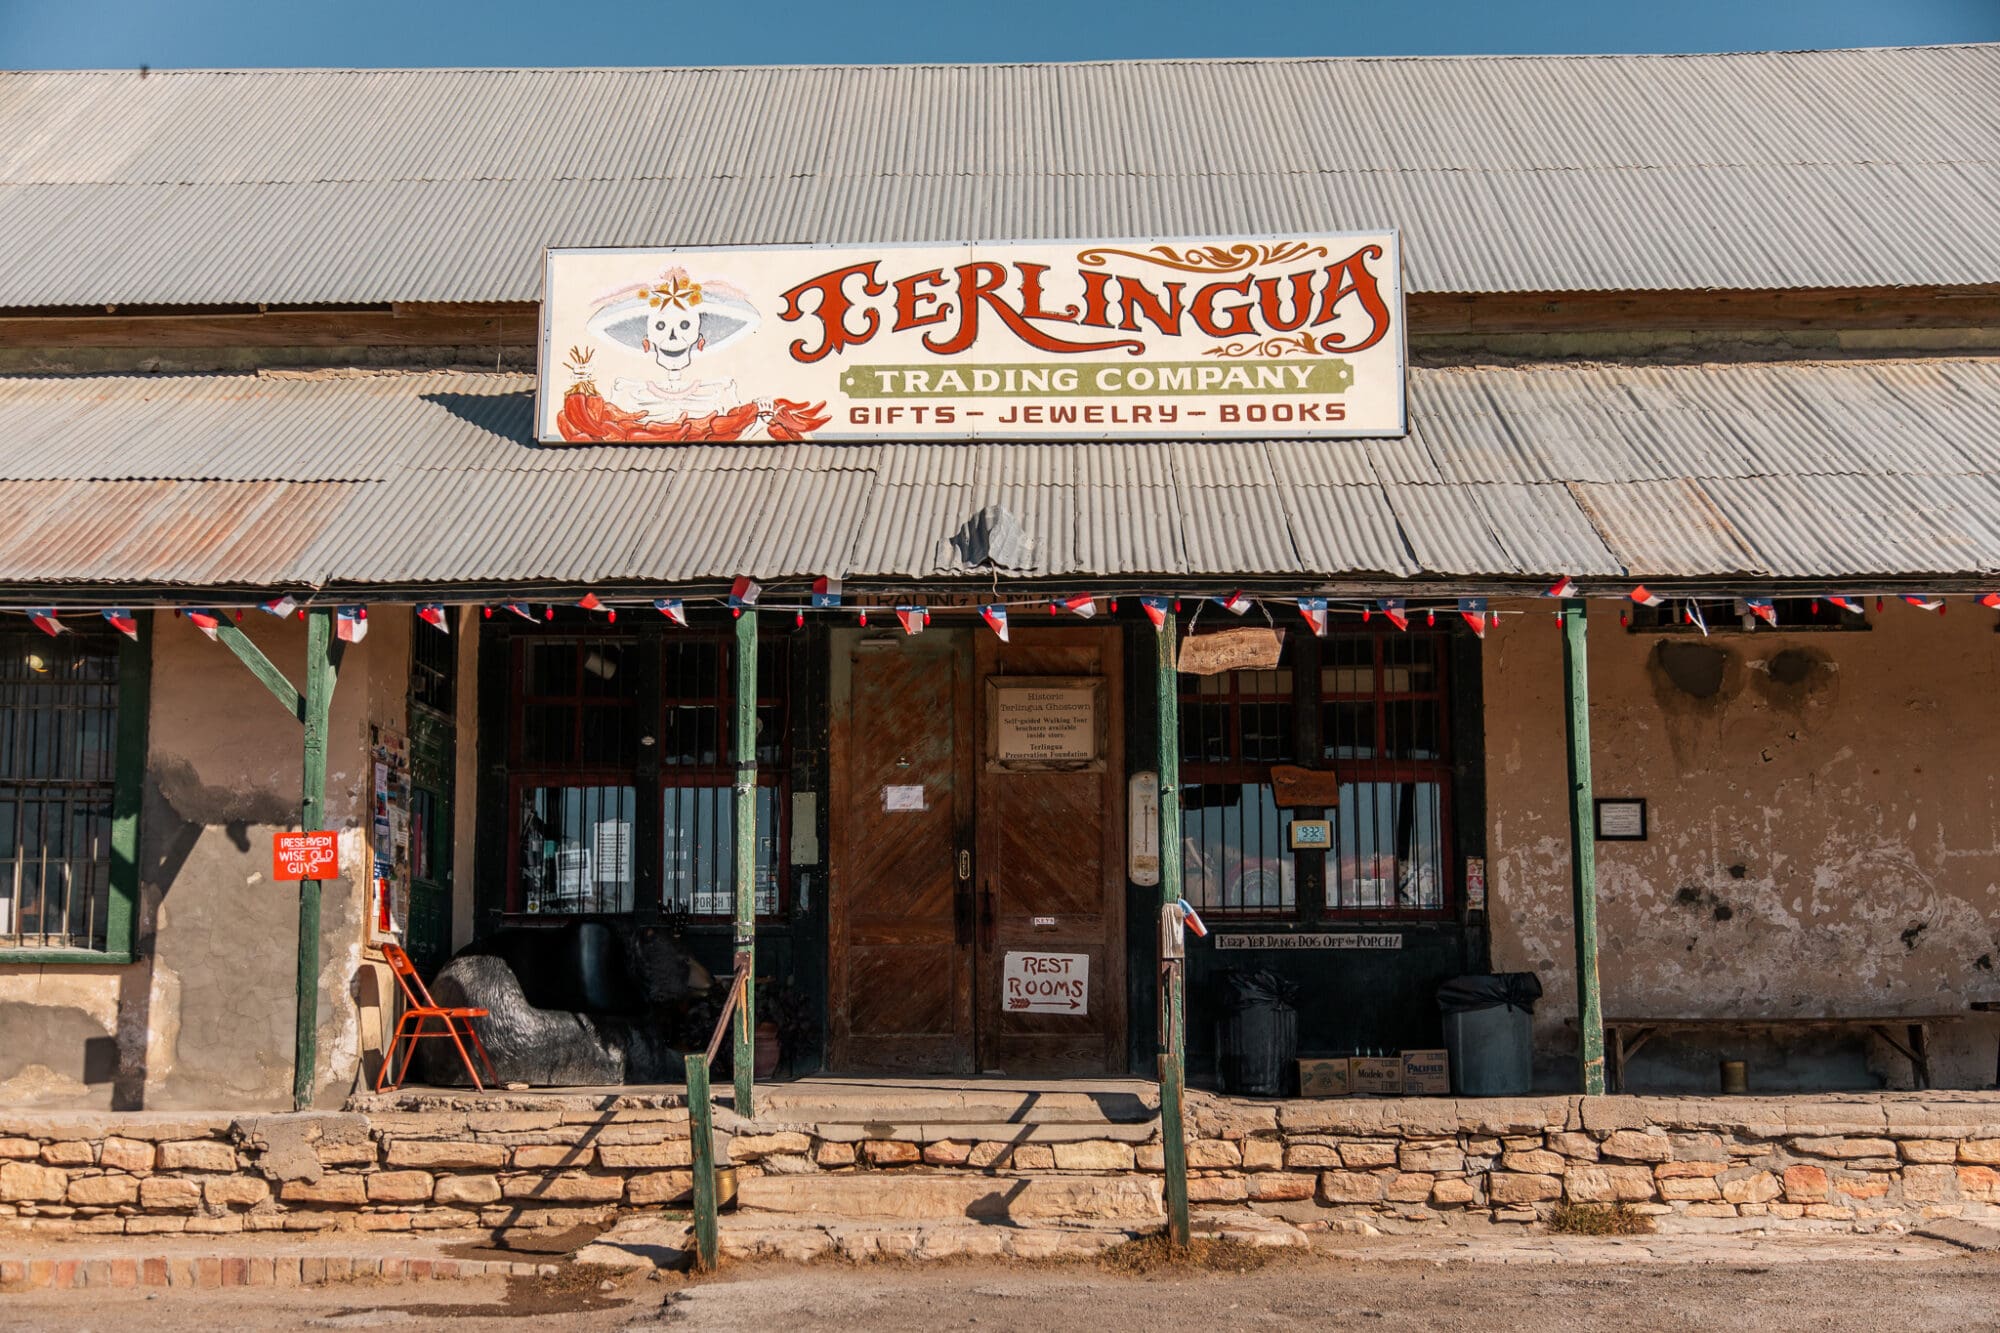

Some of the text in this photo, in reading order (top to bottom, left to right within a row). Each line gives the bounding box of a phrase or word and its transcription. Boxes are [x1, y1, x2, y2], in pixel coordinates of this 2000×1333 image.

[777, 244, 1390, 363] TERLINGUA
[874, 365, 1317, 393] TRADING COMPANY
[850, 405, 956, 425] GIFTS
[998, 404, 1178, 425] JEWELRY
[1219, 402, 1346, 423] BOOKS
[1027, 692, 1064, 701] Historic
[1000, 703, 1043, 713] Terlingua
[1030, 743, 1063, 752] Terlingua
[279, 849, 334, 862] WISE OLD
[287, 862, 319, 874] GUYS
[1219, 935, 1245, 948] KEEP
[1248, 935, 1265, 948] YER
[1266, 935, 1297, 948] DANG
[1298, 935, 1321, 948] DOG
[1323, 935, 1346, 948] OFF
[1356, 935, 1399, 948] PORCH!
[1022, 956, 1073, 976] REST
[1008, 977, 1084, 998] ROOMS
